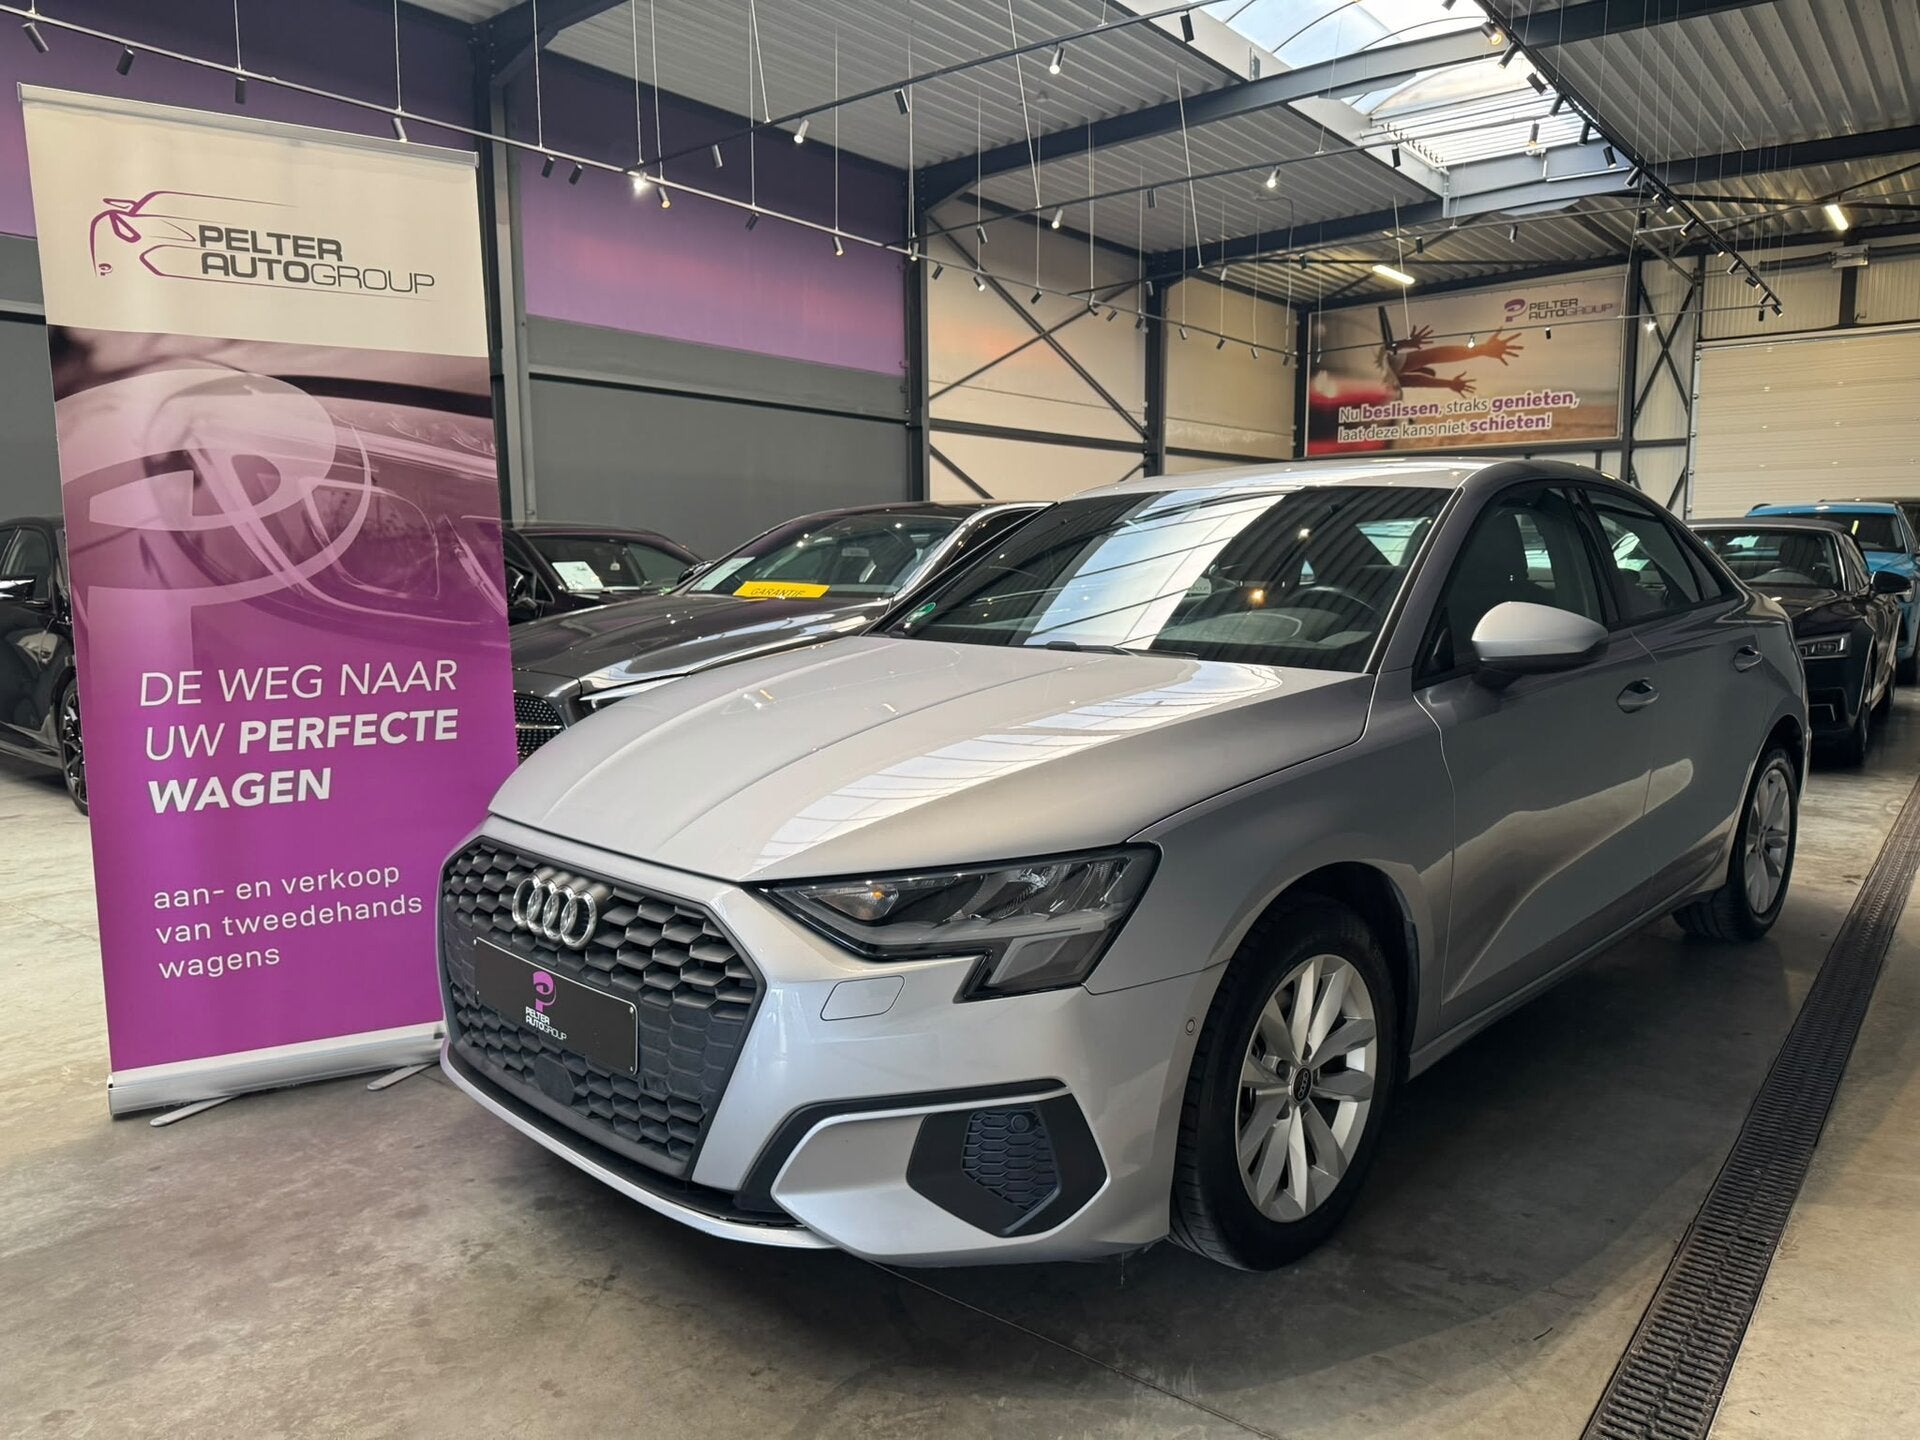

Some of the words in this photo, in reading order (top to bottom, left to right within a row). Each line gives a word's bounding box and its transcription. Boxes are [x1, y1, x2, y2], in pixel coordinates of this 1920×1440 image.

[199, 224, 343, 262] PELTER
[201, 252, 435, 294] AUTOGROUP
[1529, 298, 1579, 312] PELTER
[1529, 303, 1613, 320] AUTOGROUP
[1339, 407, 1359, 422] Nu
[1362, 403, 1442, 420] beslissen,
[1446, 398, 1488, 413] straks
[1492, 391, 1579, 412] genieten,
[1338, 427, 1363, 441] laat
[1366, 424, 1398, 439] deze
[1402, 423, 1434, 437] kans
[1437, 420, 1466, 435] niet
[1469, 415, 1551, 432] schieten!
[751, 588, 805, 598] GARANTIE
[140, 670, 203, 707] DE
[218, 664, 323, 702] WEG
[340, 659, 458, 697] NAAR
[145, 722, 225, 761] UW
[239, 708, 459, 754] PERFECTE
[147, 767, 332, 814] WAGEN
[153, 887, 225, 910] aan-
[235, 880, 271, 900] en
[281, 865, 400, 896] verkoop
[156, 923, 211, 945] van
[222, 894, 423, 937] tweedehands
[158, 946, 280, 979] wagens
[525, 1006, 550, 1024] PELTER
[525, 1015, 568, 1041] AUTOGROUP
